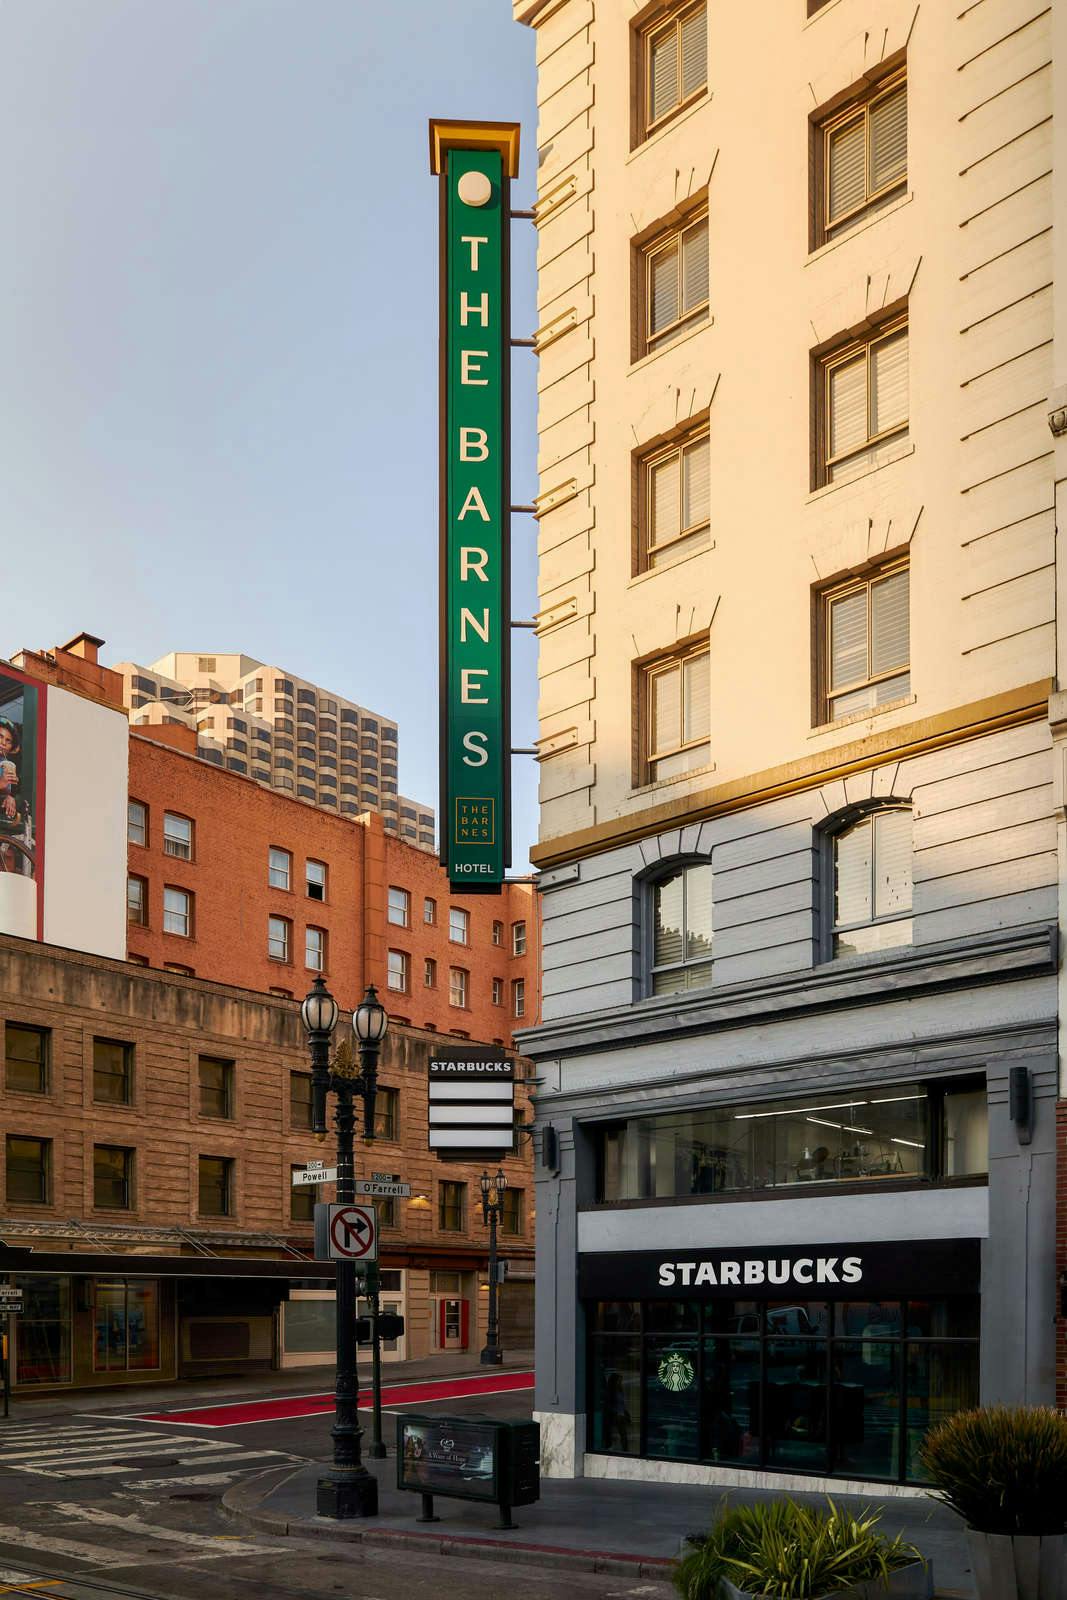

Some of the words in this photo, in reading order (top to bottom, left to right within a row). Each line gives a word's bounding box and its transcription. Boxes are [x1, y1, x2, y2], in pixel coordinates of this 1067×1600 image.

[459, 235, 489, 386] THE
[458, 426, 490, 768] BARNES
[462, 805, 489, 815] THE
[461, 816, 489, 825] BAR
[461, 828, 488, 837] NES
[455, 863, 495, 874] HOTEL
[430, 1061, 512, 1072] STARBUCKS
[302, 1172, 328, 1182] Powell
[364, 1183, 404, 1195] O'Farrell
[658, 1256, 863, 1287] STARBUCKS
